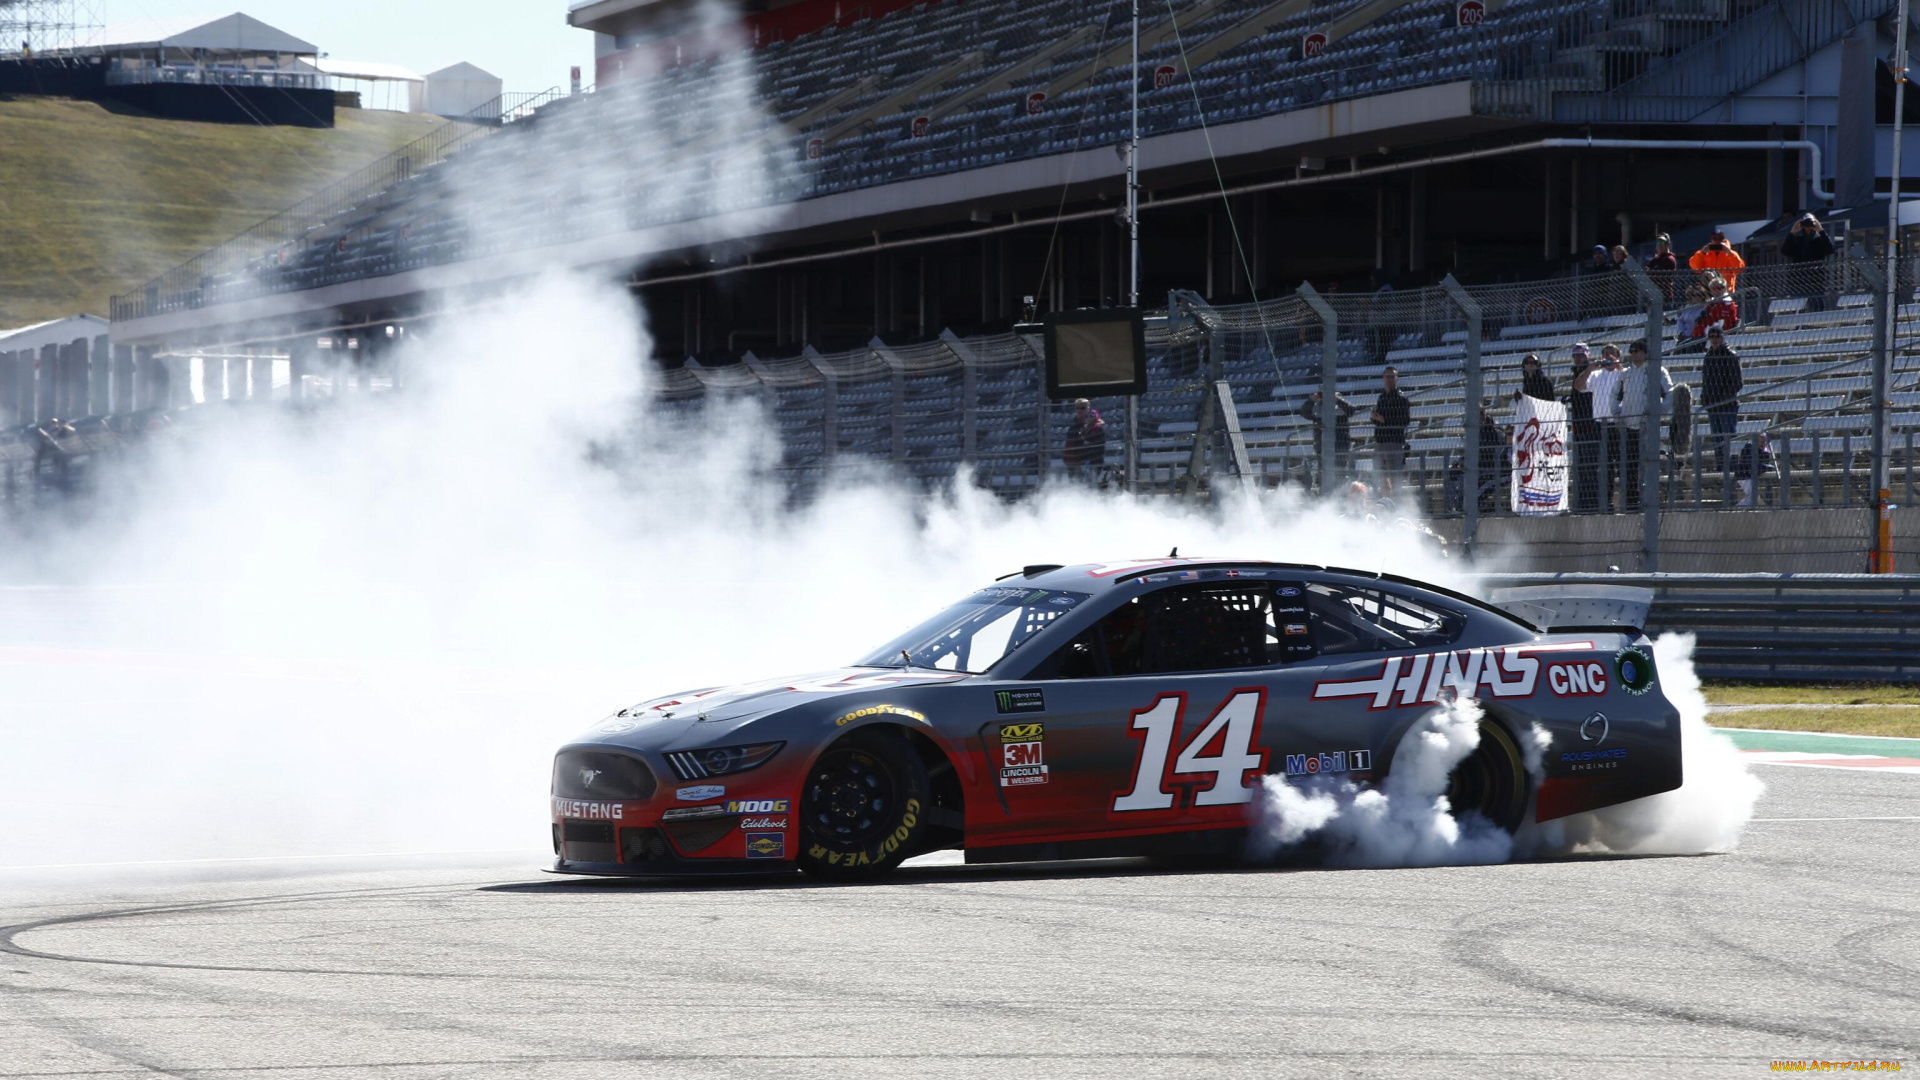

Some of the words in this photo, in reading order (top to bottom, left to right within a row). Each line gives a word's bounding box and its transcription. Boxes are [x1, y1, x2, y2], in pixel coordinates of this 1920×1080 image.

[1462, 8, 1483, 24] 205
[1614, 645, 1650, 663] AMERICAN
[1311, 641, 1595, 710] HAAS
[1548, 663, 1606, 695] CNC
[1621, 680, 1654, 696] ETHANOL
[835, 703, 925, 727] GOODYEAR
[1006, 743, 1040, 766] 3M
[1111, 690, 1267, 815] 14
[1286, 751, 1346, 776] Mobil
[1571, 761, 1618, 771] ENGINES
[1003, 768, 1040, 777] LINCOLN
[1011, 776, 1044, 785] WELDERS
[556, 800, 623, 819] MUSTANG
[727, 800, 788, 813] MOOG
[740, 817, 787, 829] Edelbrock
[808, 798, 920, 867] GOODYEAR
[749, 842, 782, 850] SUNOCO
